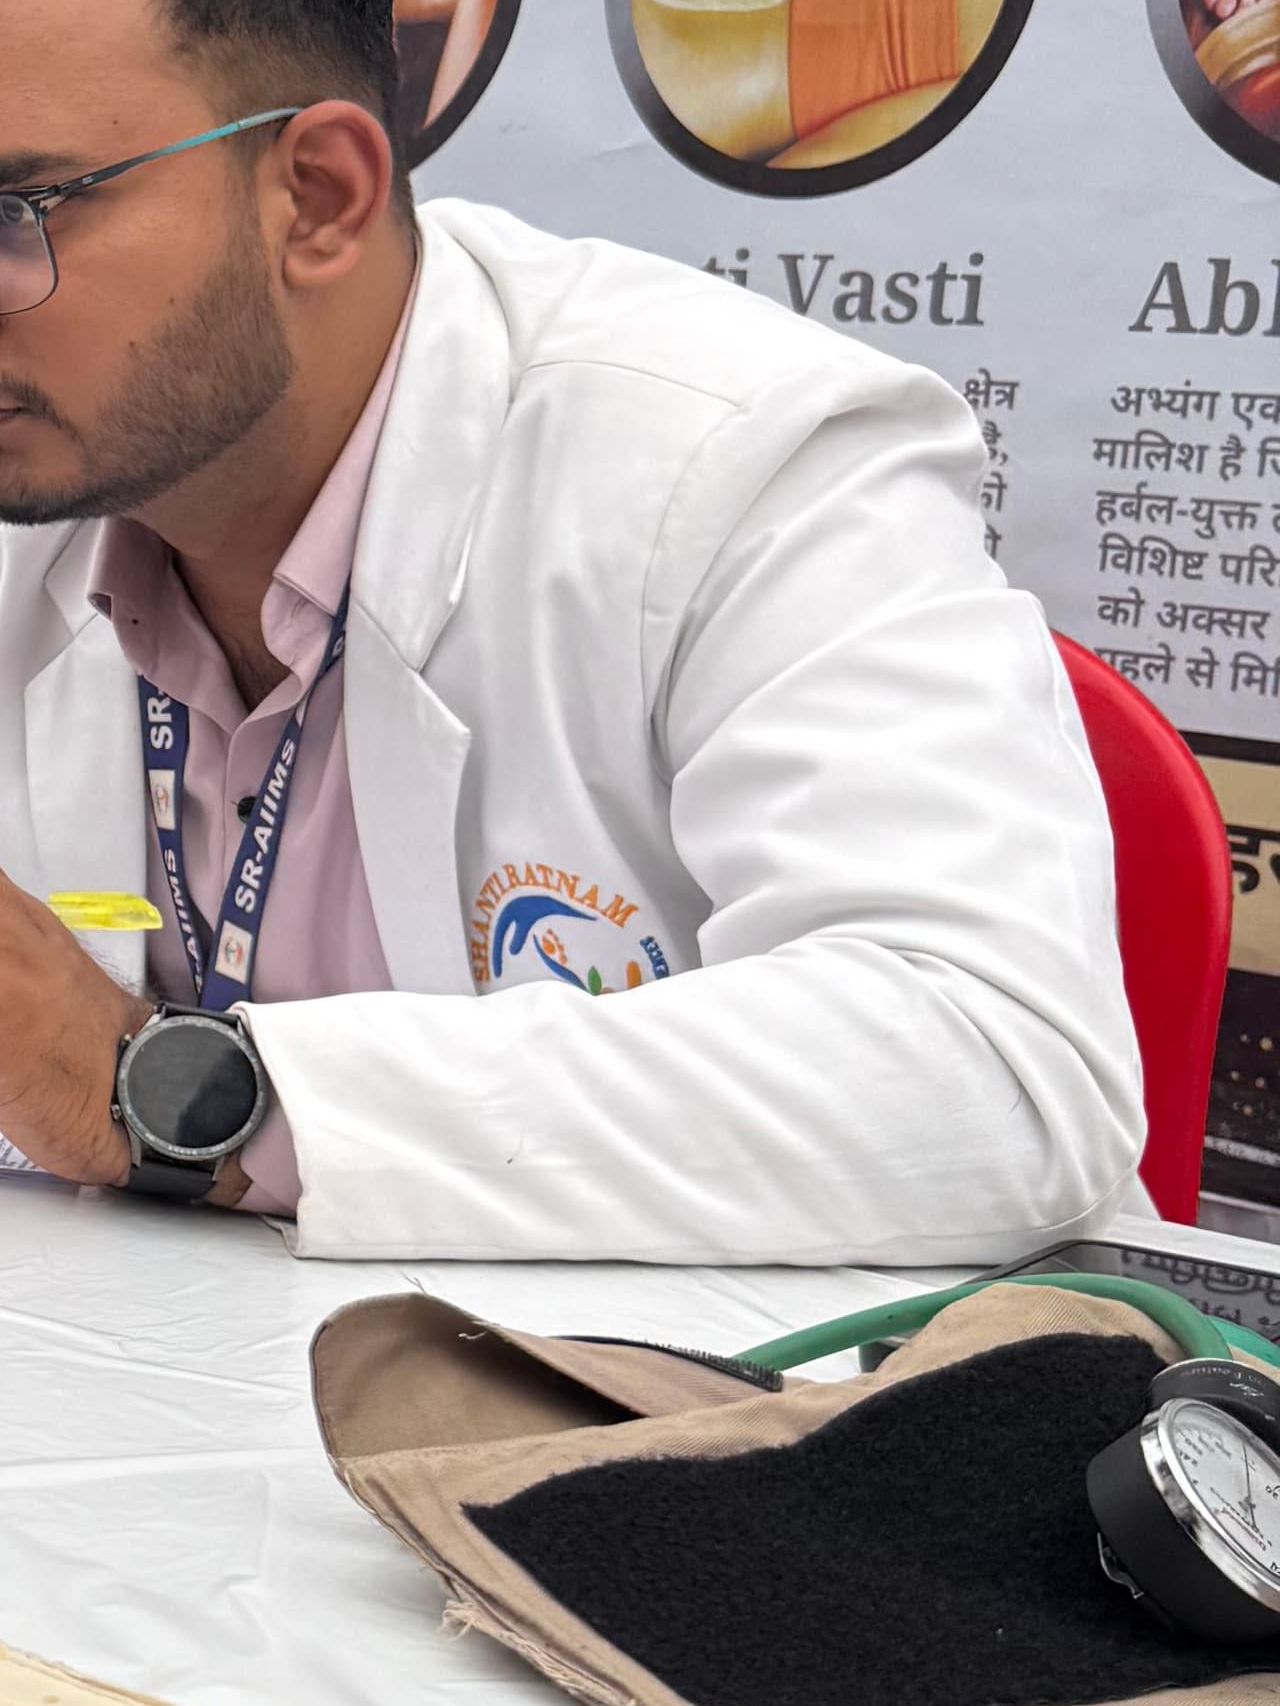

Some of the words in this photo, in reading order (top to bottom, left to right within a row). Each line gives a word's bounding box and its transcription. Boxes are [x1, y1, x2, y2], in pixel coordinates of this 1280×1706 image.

[777, 250, 986, 328] Vasti
[1111, 379, 1221, 422] अभ्यंग
[1093, 429, 1211, 474] मालिश
[1219, 433, 1247, 481] है
[1095, 481, 1262, 540] हर्बल-युक्त
[1098, 531, 1209, 581] विशिष्ट
[1097, 586, 1146, 628] को
[1156, 601, 1271, 641] अक्सर
[1185, 646, 1220, 690] से
[234, 737, 297, 914] SR-AIIMS
